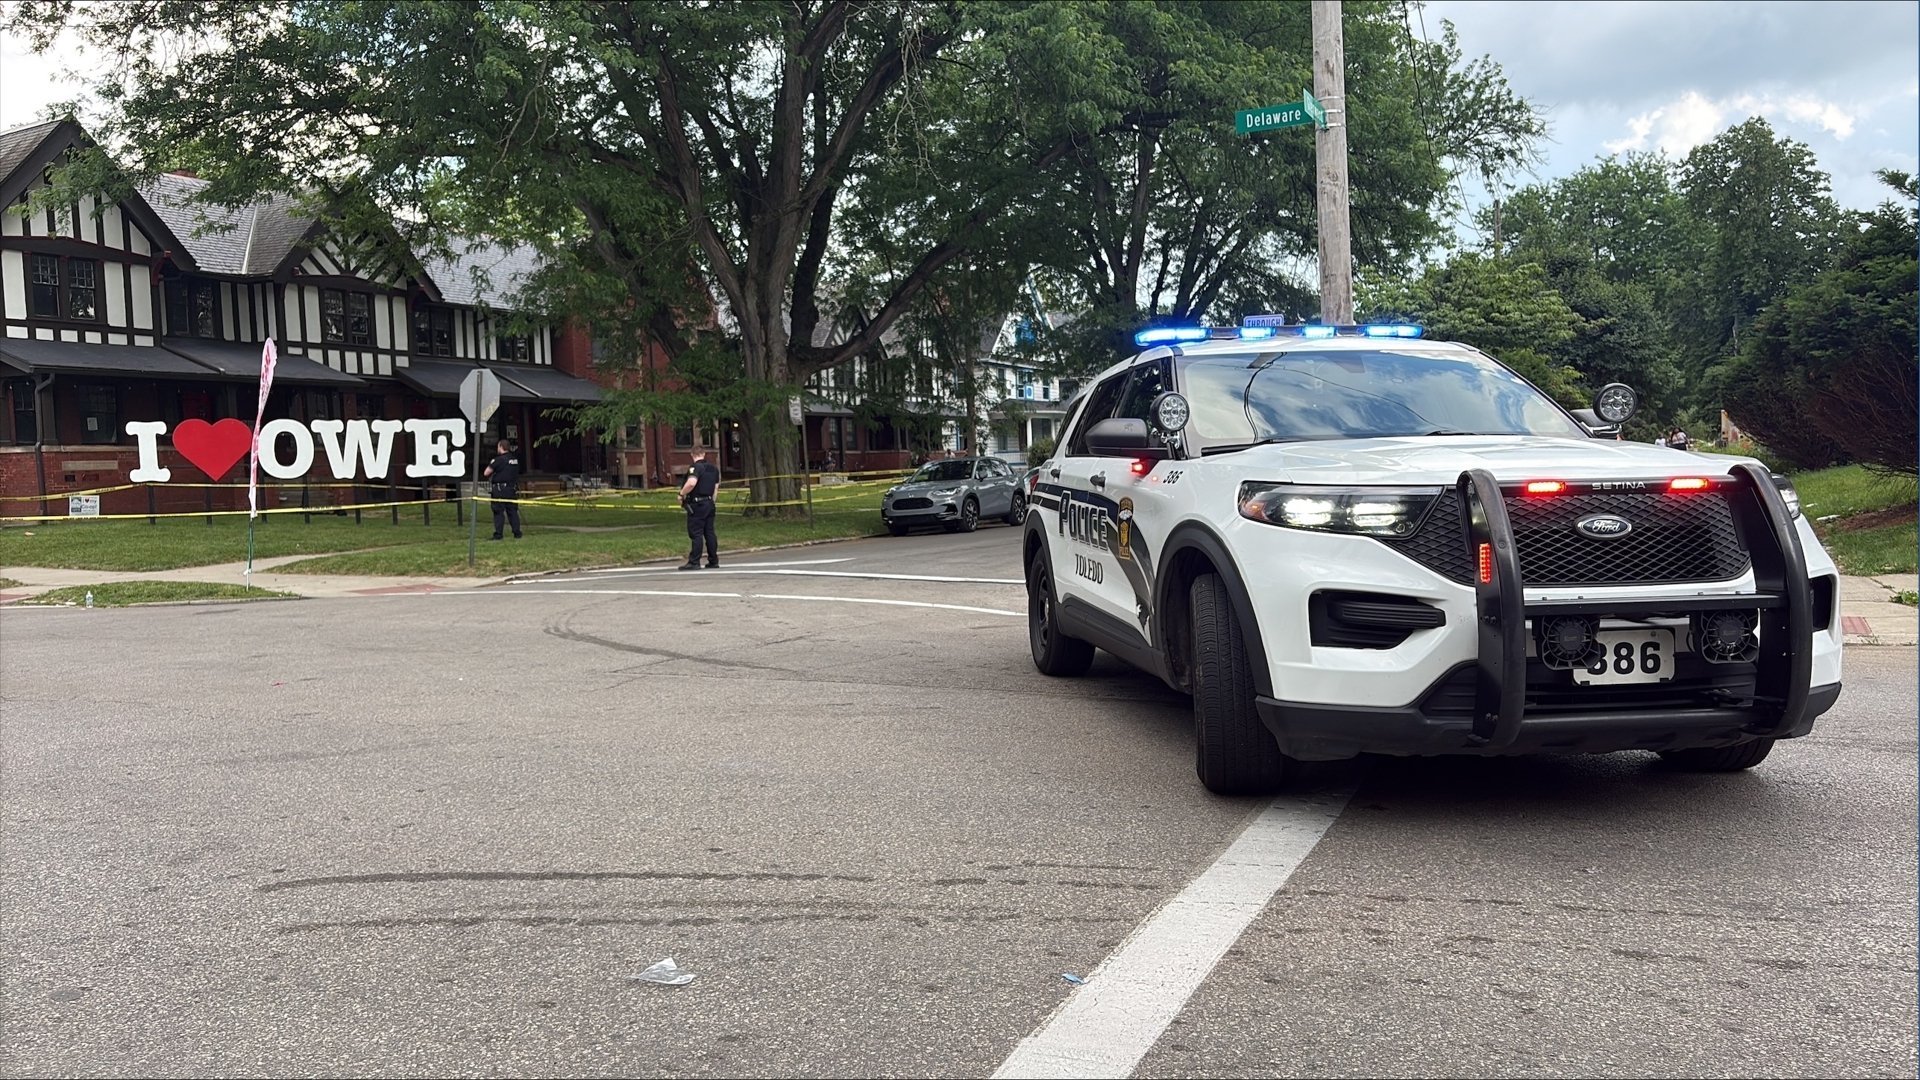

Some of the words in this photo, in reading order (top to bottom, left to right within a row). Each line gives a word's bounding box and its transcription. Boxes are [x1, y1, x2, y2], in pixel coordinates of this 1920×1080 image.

[1246, 109, 1301, 128] Delaware
[1246, 318, 1281, 327] THROUGH
[125, 421, 171, 483] I
[258, 418, 466, 480] OWE
[1163, 470, 1183, 484] 386
[1592, 481, 1646, 490] SETINA
[1592, 519, 1620, 532] Ford
[1075, 553, 1104, 584] TOLEDO
